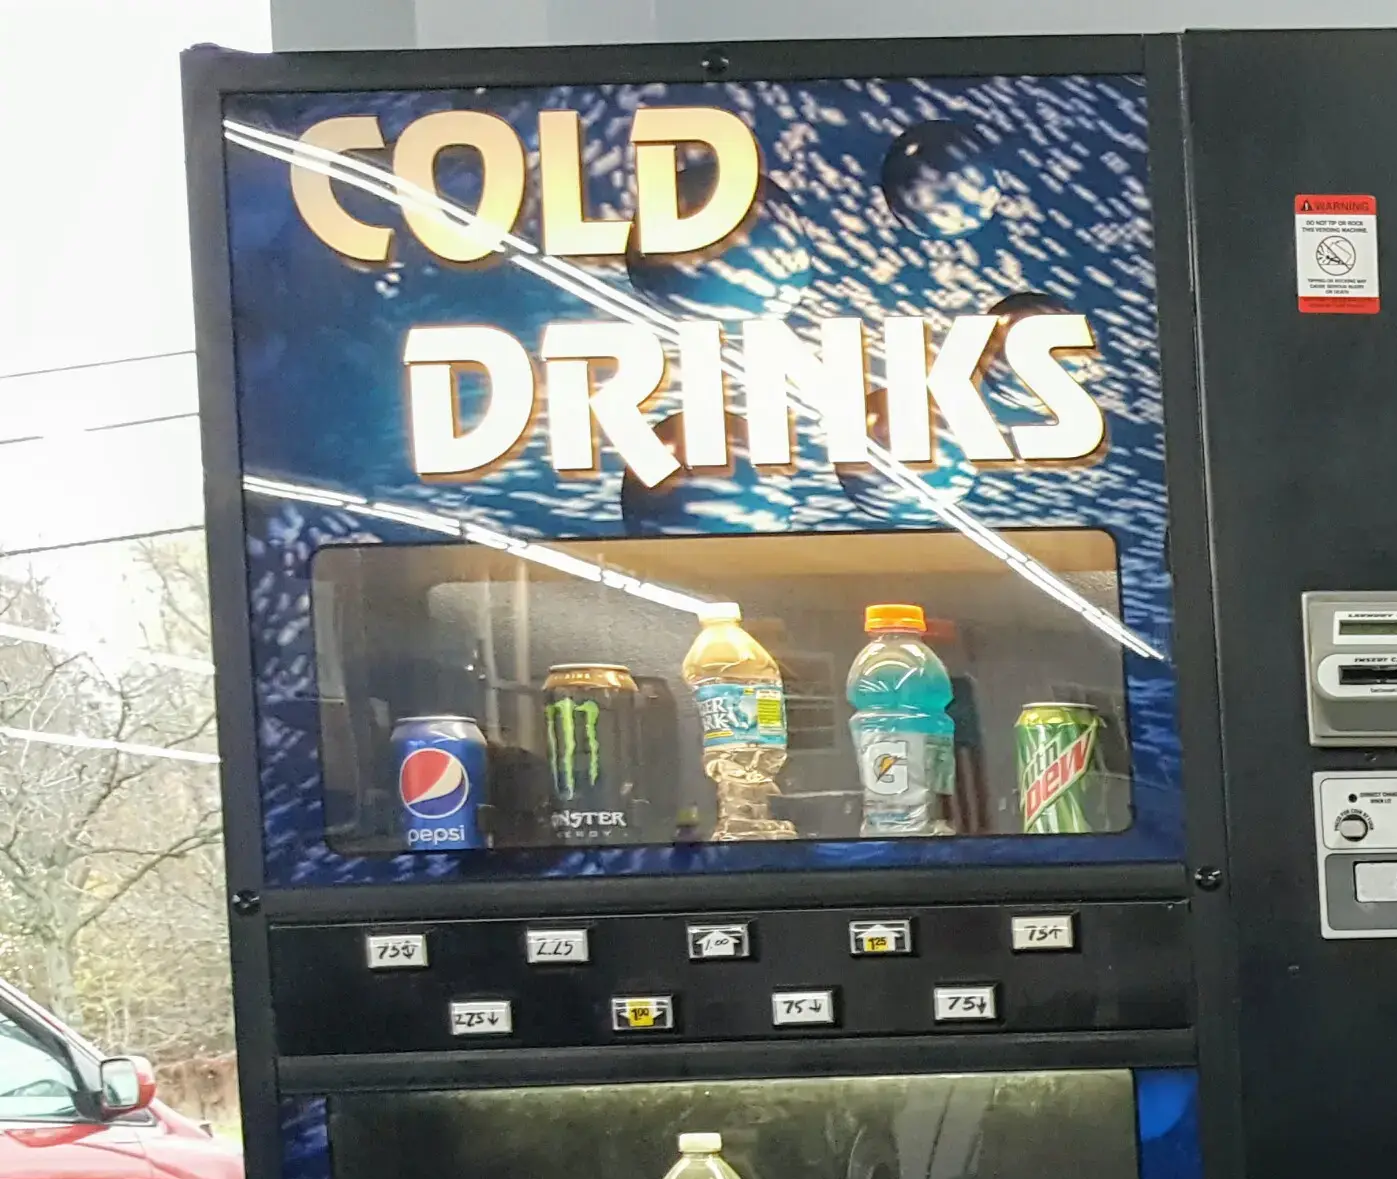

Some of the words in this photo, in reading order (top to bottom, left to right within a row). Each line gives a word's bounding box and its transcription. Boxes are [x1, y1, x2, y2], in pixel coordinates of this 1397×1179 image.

[290, 106, 760, 263] COLD
[405, 314, 1108, 487] DRINKS
[407, 824, 466, 846] pepsi
[704, 937, 731, 952] 1.00
[783, 999, 807, 1015] 75
[948, 996, 976, 1012] 75
